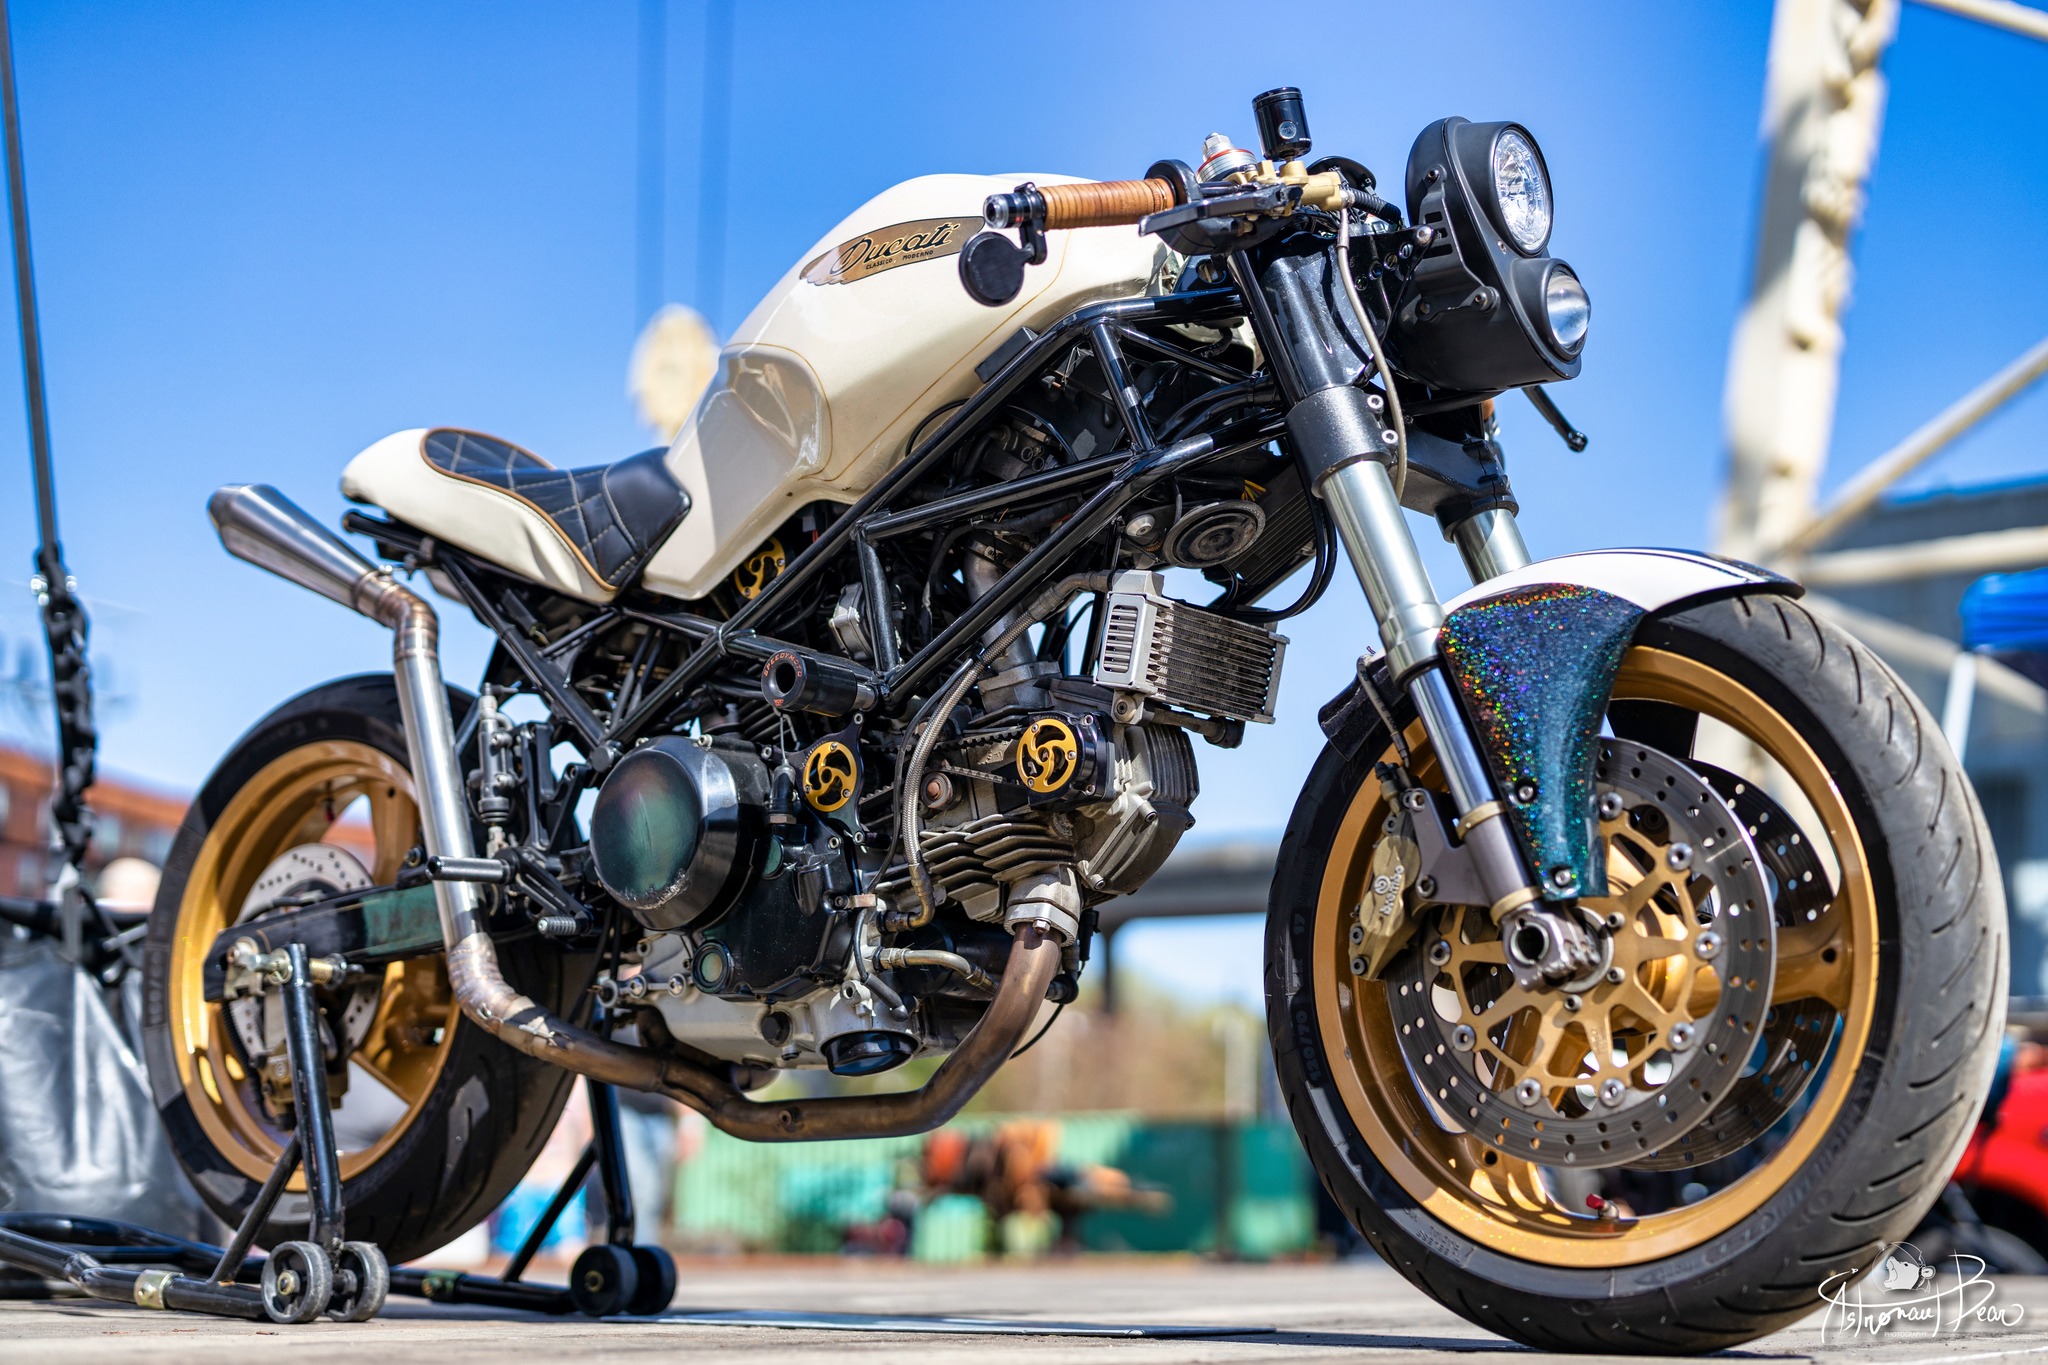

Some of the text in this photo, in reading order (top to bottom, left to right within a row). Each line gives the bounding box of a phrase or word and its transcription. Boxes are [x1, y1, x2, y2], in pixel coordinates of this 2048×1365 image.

[830, 222, 961, 276] Ducati
[865, 250, 934, 270] CLASSICO MODERNO
[1380, 865, 1405, 916] brembo
[1294, 913, 1305, 935] 17
[1295, 1010, 1322, 1081] 120/70
